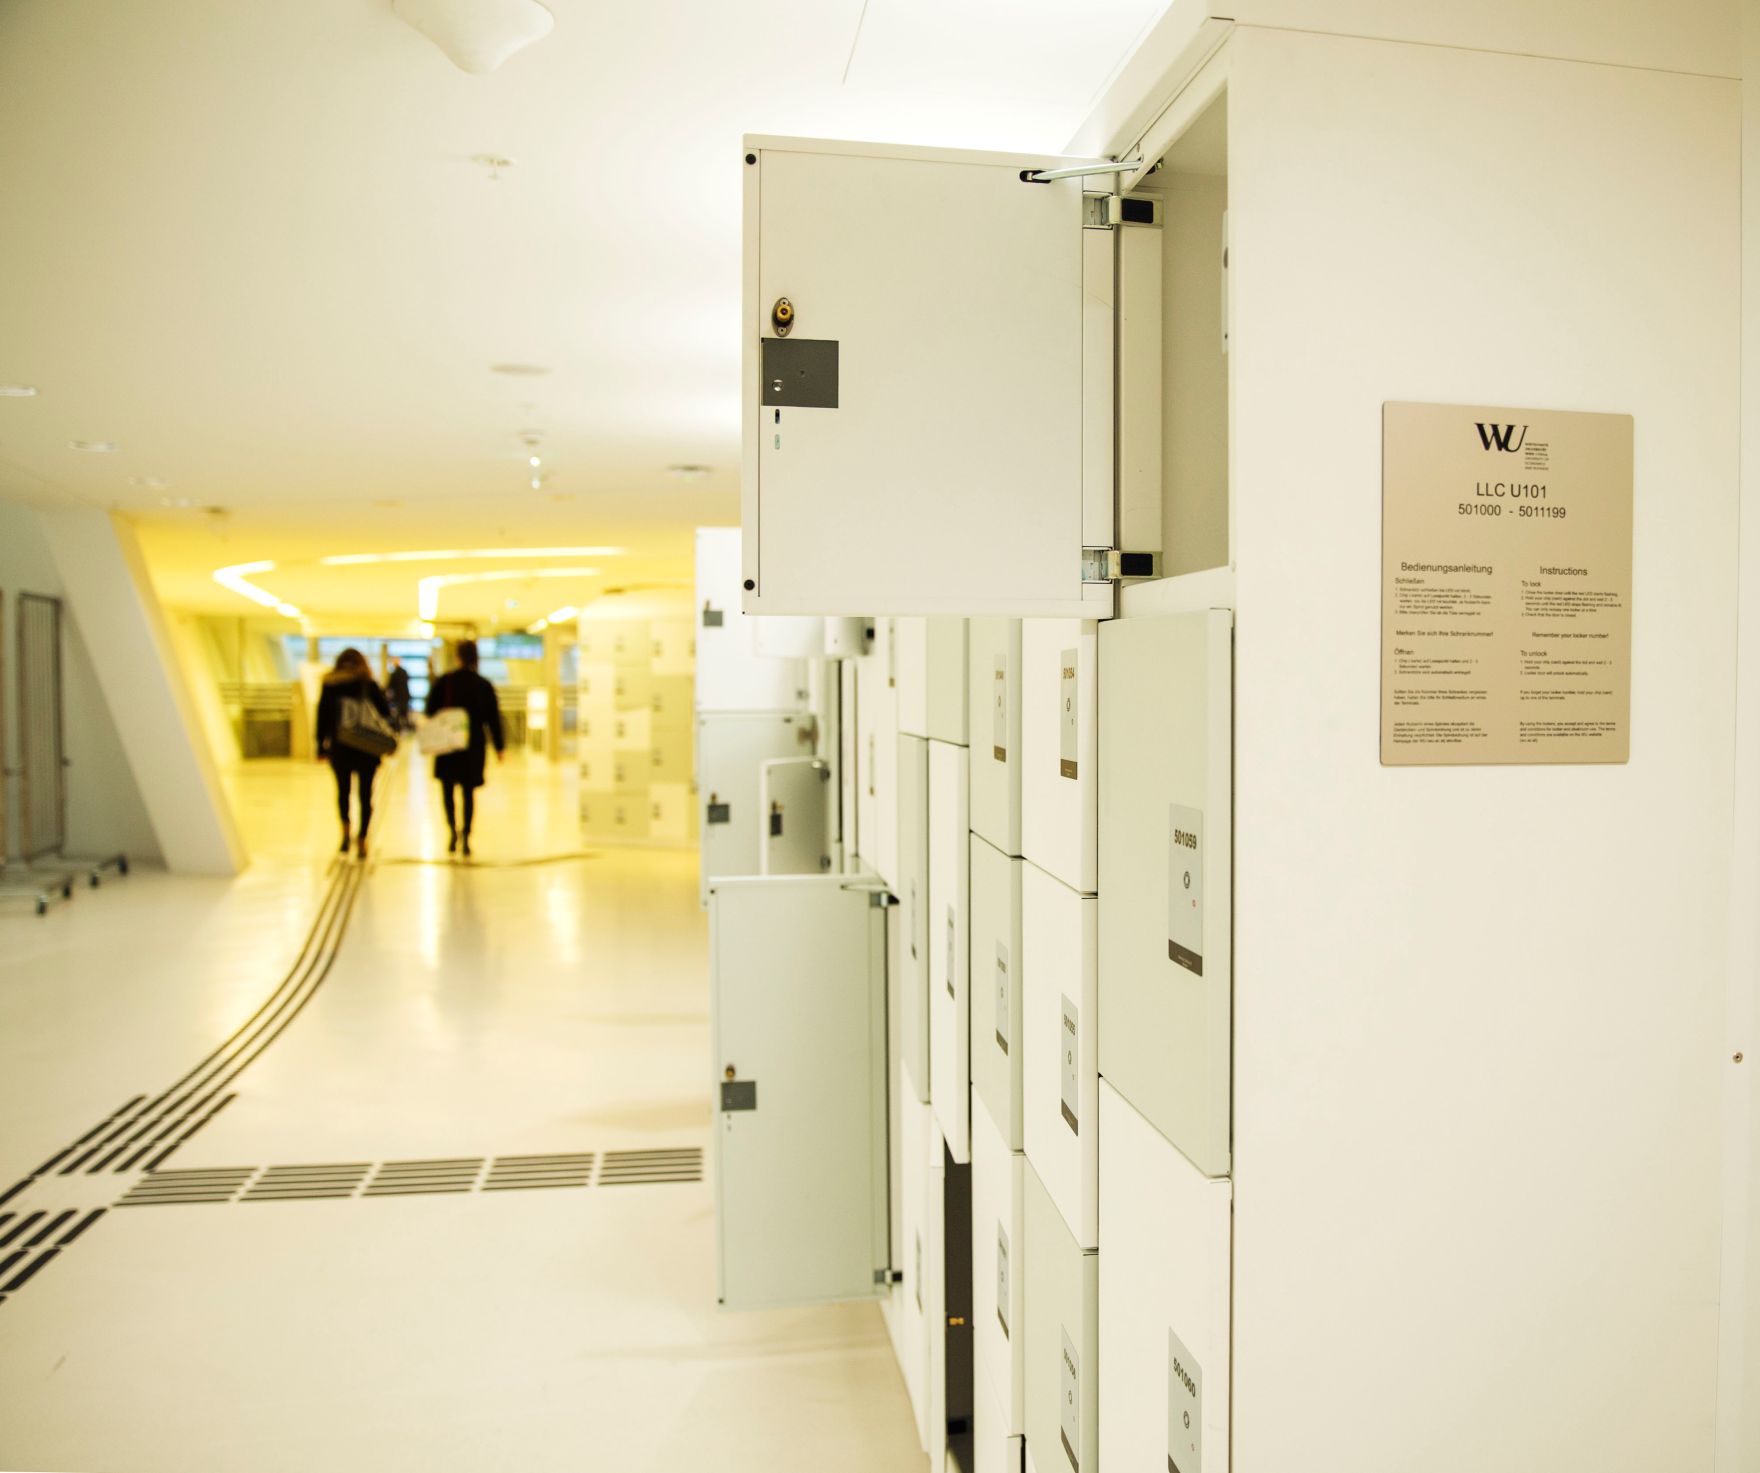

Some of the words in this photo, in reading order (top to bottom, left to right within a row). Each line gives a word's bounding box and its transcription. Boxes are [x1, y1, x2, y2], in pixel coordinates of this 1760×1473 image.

[1474, 422, 1528, 453] WU
[1477, 482, 1505, 497] LLC
[1510, 483, 1546, 499] U101
[1458, 503, 1501, 516] 501000
[1518, 505, 1566, 518] 5011199
[1400, 562, 1493, 576] Bedienungsanleitung
[1540, 566, 1588, 576] Instructions
[1521, 580, 1529, 588] To
[1174, 829, 1197, 850] 501059
